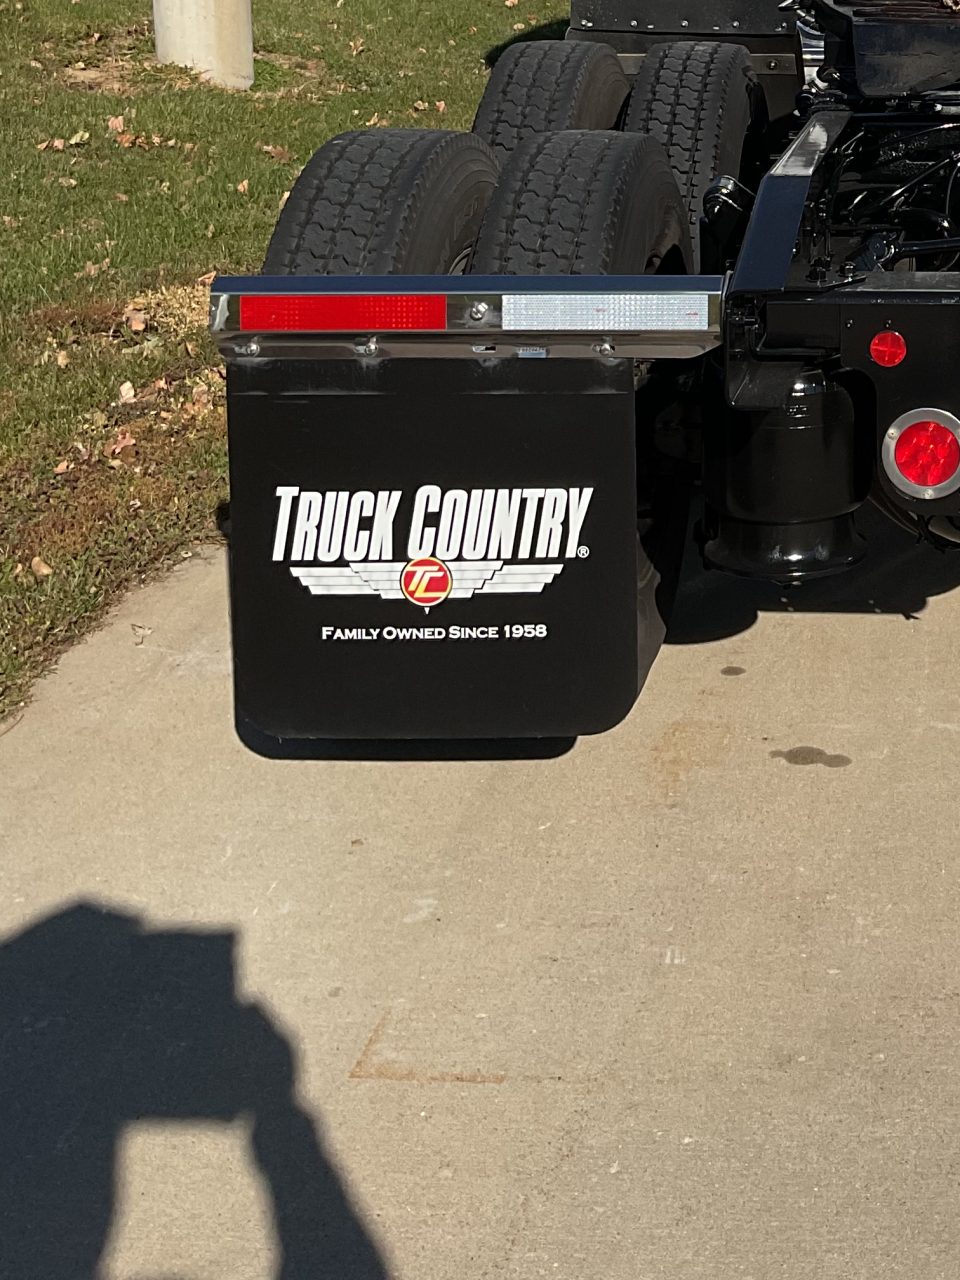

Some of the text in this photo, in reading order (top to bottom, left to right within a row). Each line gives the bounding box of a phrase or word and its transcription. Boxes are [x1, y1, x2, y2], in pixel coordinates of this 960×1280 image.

[272, 486, 403, 562] TRUCK
[321, 624, 548, 640] FAMILY OWNED SINCE 1958
